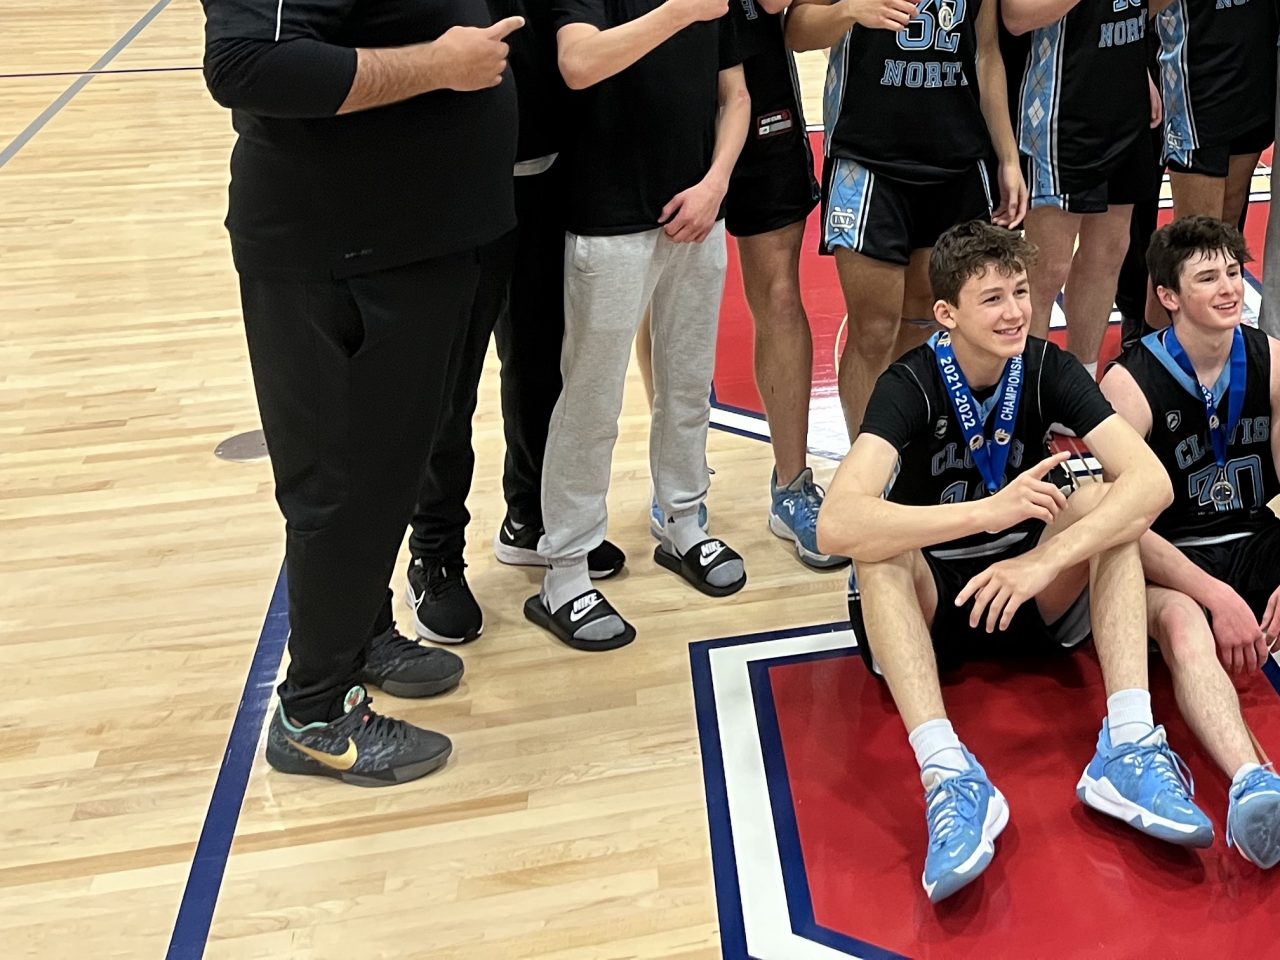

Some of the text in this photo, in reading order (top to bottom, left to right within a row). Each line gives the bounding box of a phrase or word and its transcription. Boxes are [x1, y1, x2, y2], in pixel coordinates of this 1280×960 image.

[940, 356, 976, 430] 2021-2022
[1000, 353, 1023, 421] CHAMPIONSH
[701, 540, 722, 557] NIKE
[573, 592, 598, 613] NIKE
